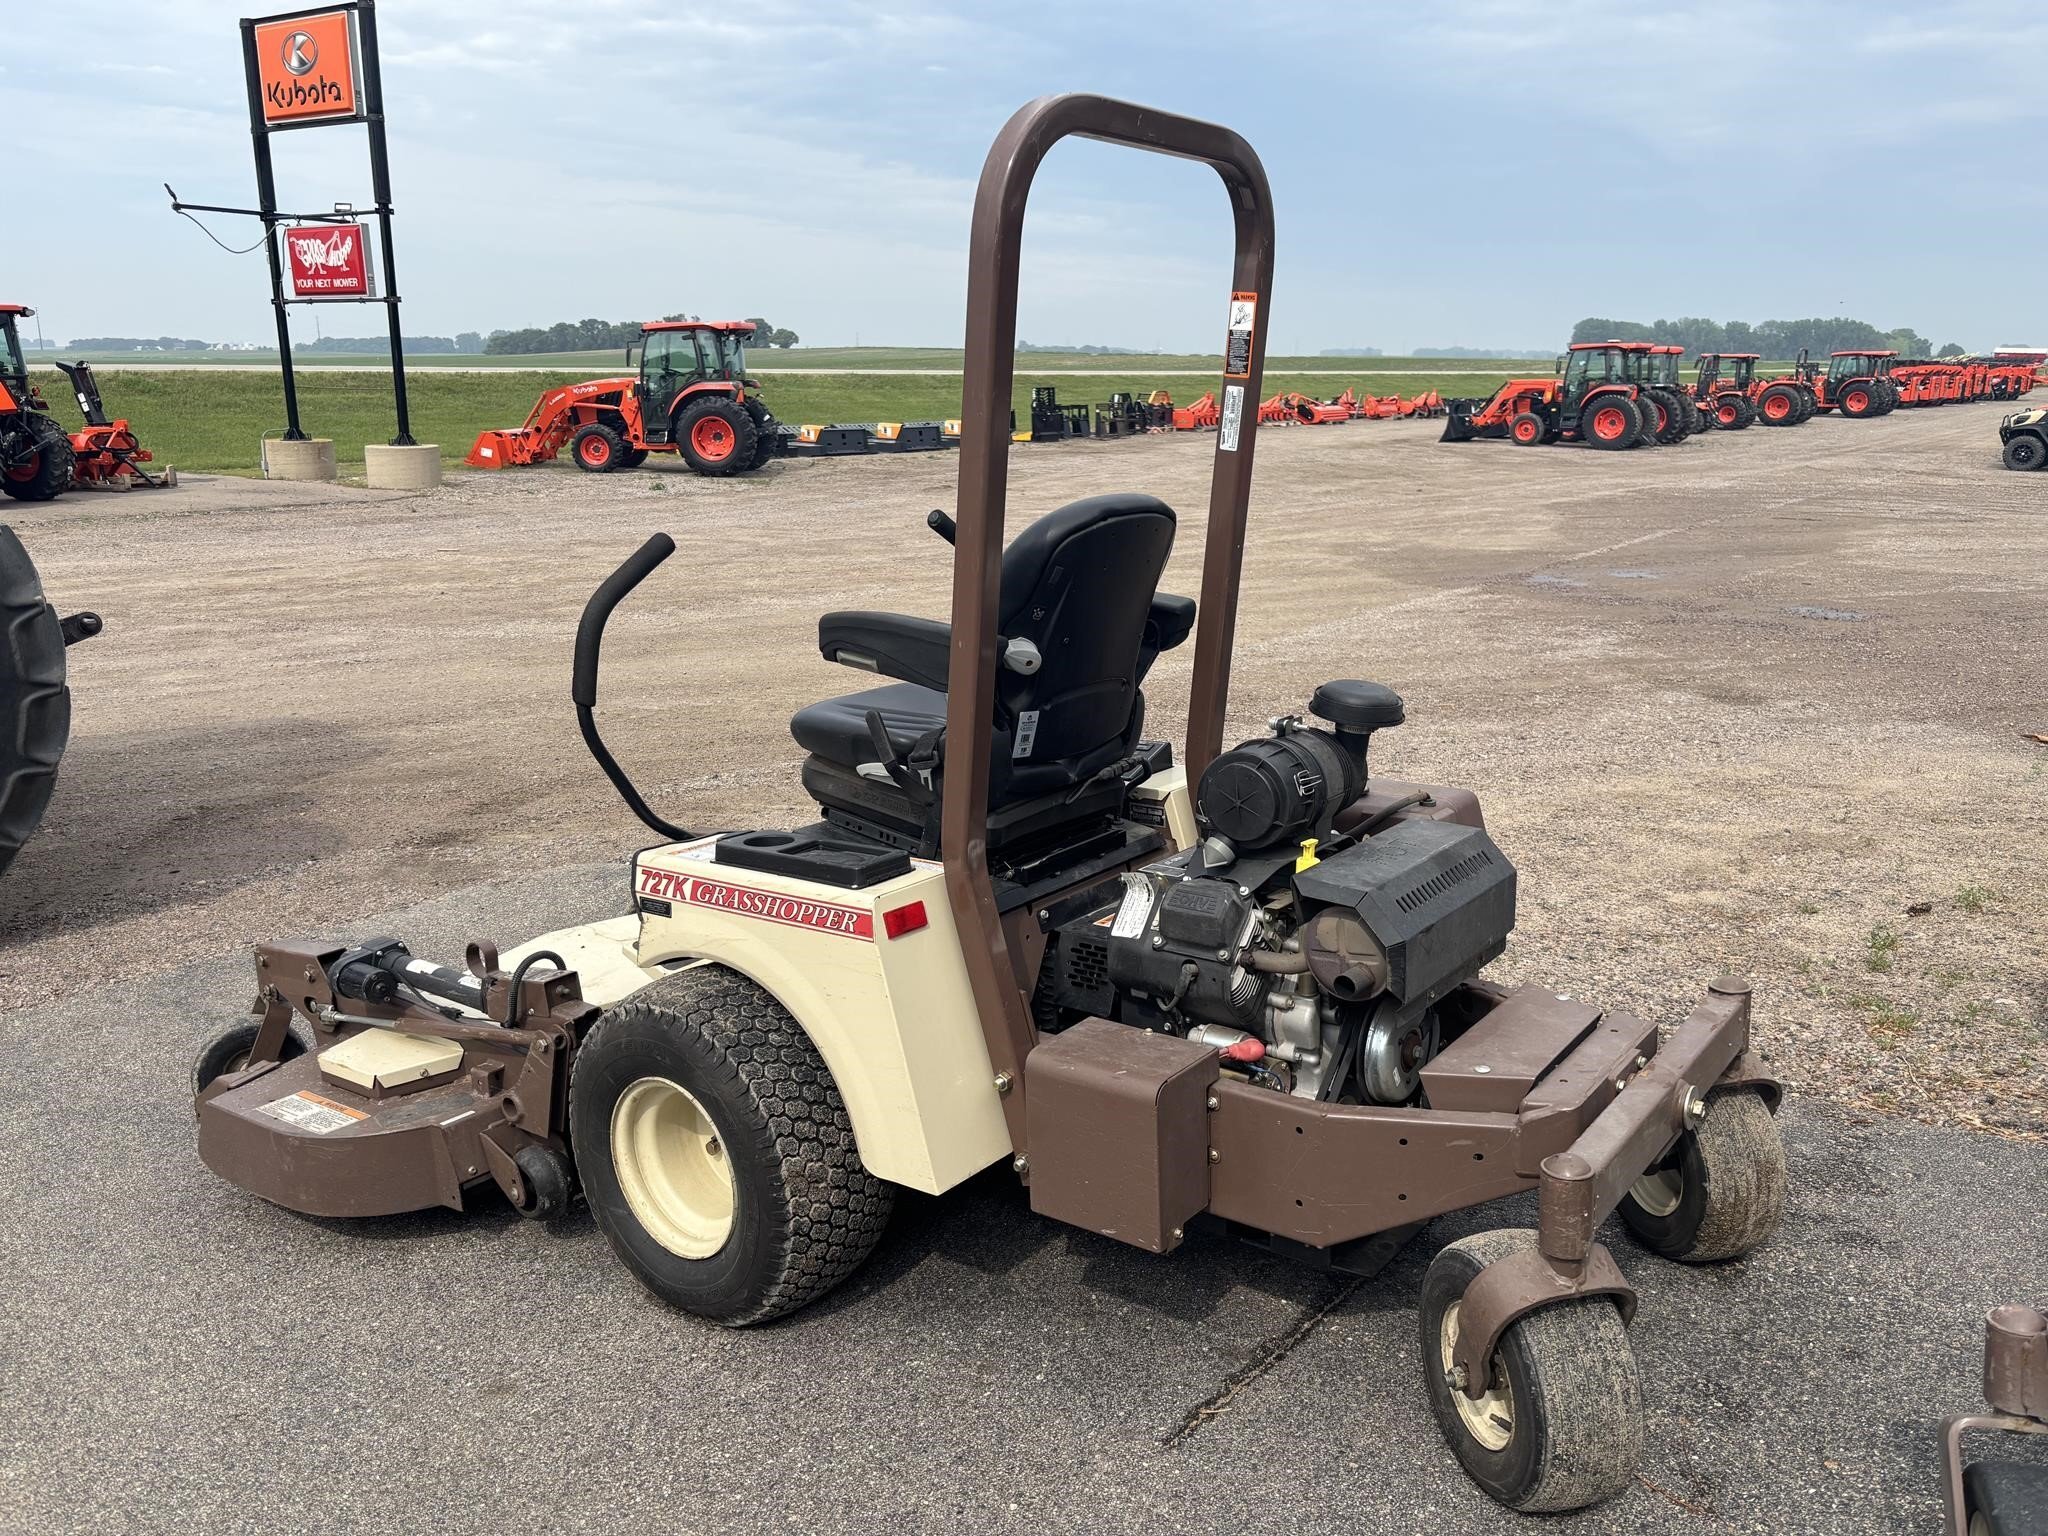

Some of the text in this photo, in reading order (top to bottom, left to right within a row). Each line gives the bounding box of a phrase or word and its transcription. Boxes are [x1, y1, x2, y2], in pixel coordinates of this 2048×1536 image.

[267, 75, 342, 108] Kubota
[296, 278, 358, 288] YOUR NEXT MOWER
[641, 869, 690, 900] 727K
[696, 884, 858, 933] GRASSHOPPER
